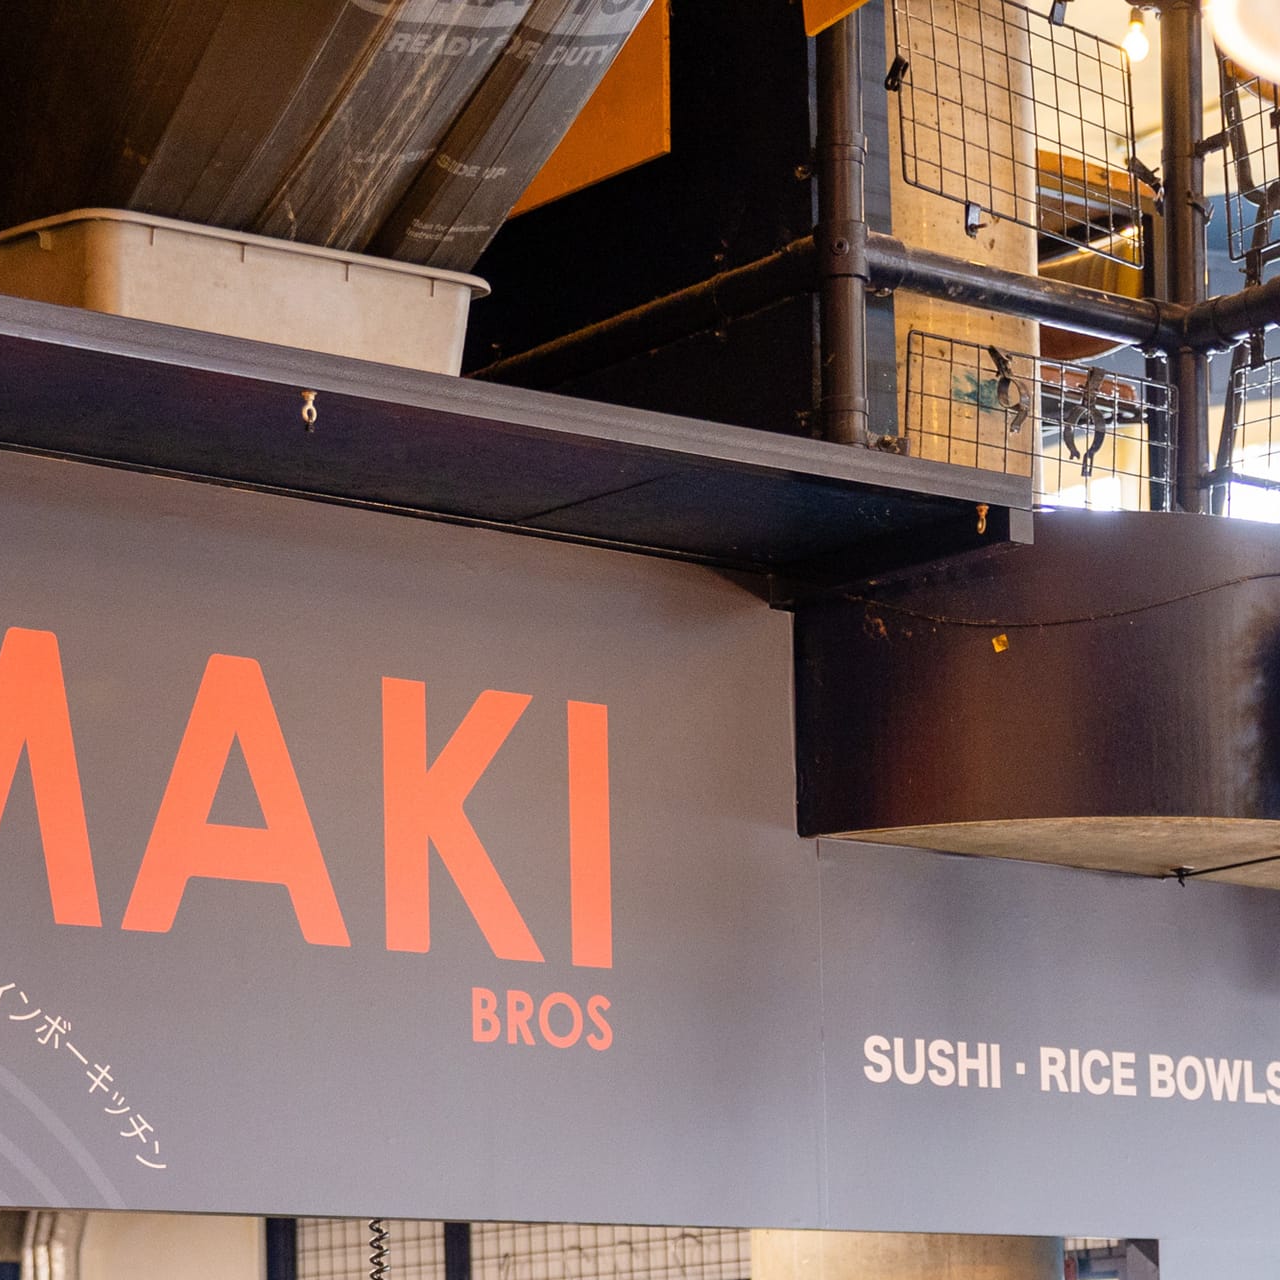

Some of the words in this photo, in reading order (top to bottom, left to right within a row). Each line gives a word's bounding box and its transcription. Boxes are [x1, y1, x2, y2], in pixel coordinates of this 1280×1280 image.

[385, 33, 490, 56] READY
[471, 986, 613, 1050] BROS
[863, 1035, 1001, 1089] SUSHI
[1040, 1046, 1137, 1097] RICE
